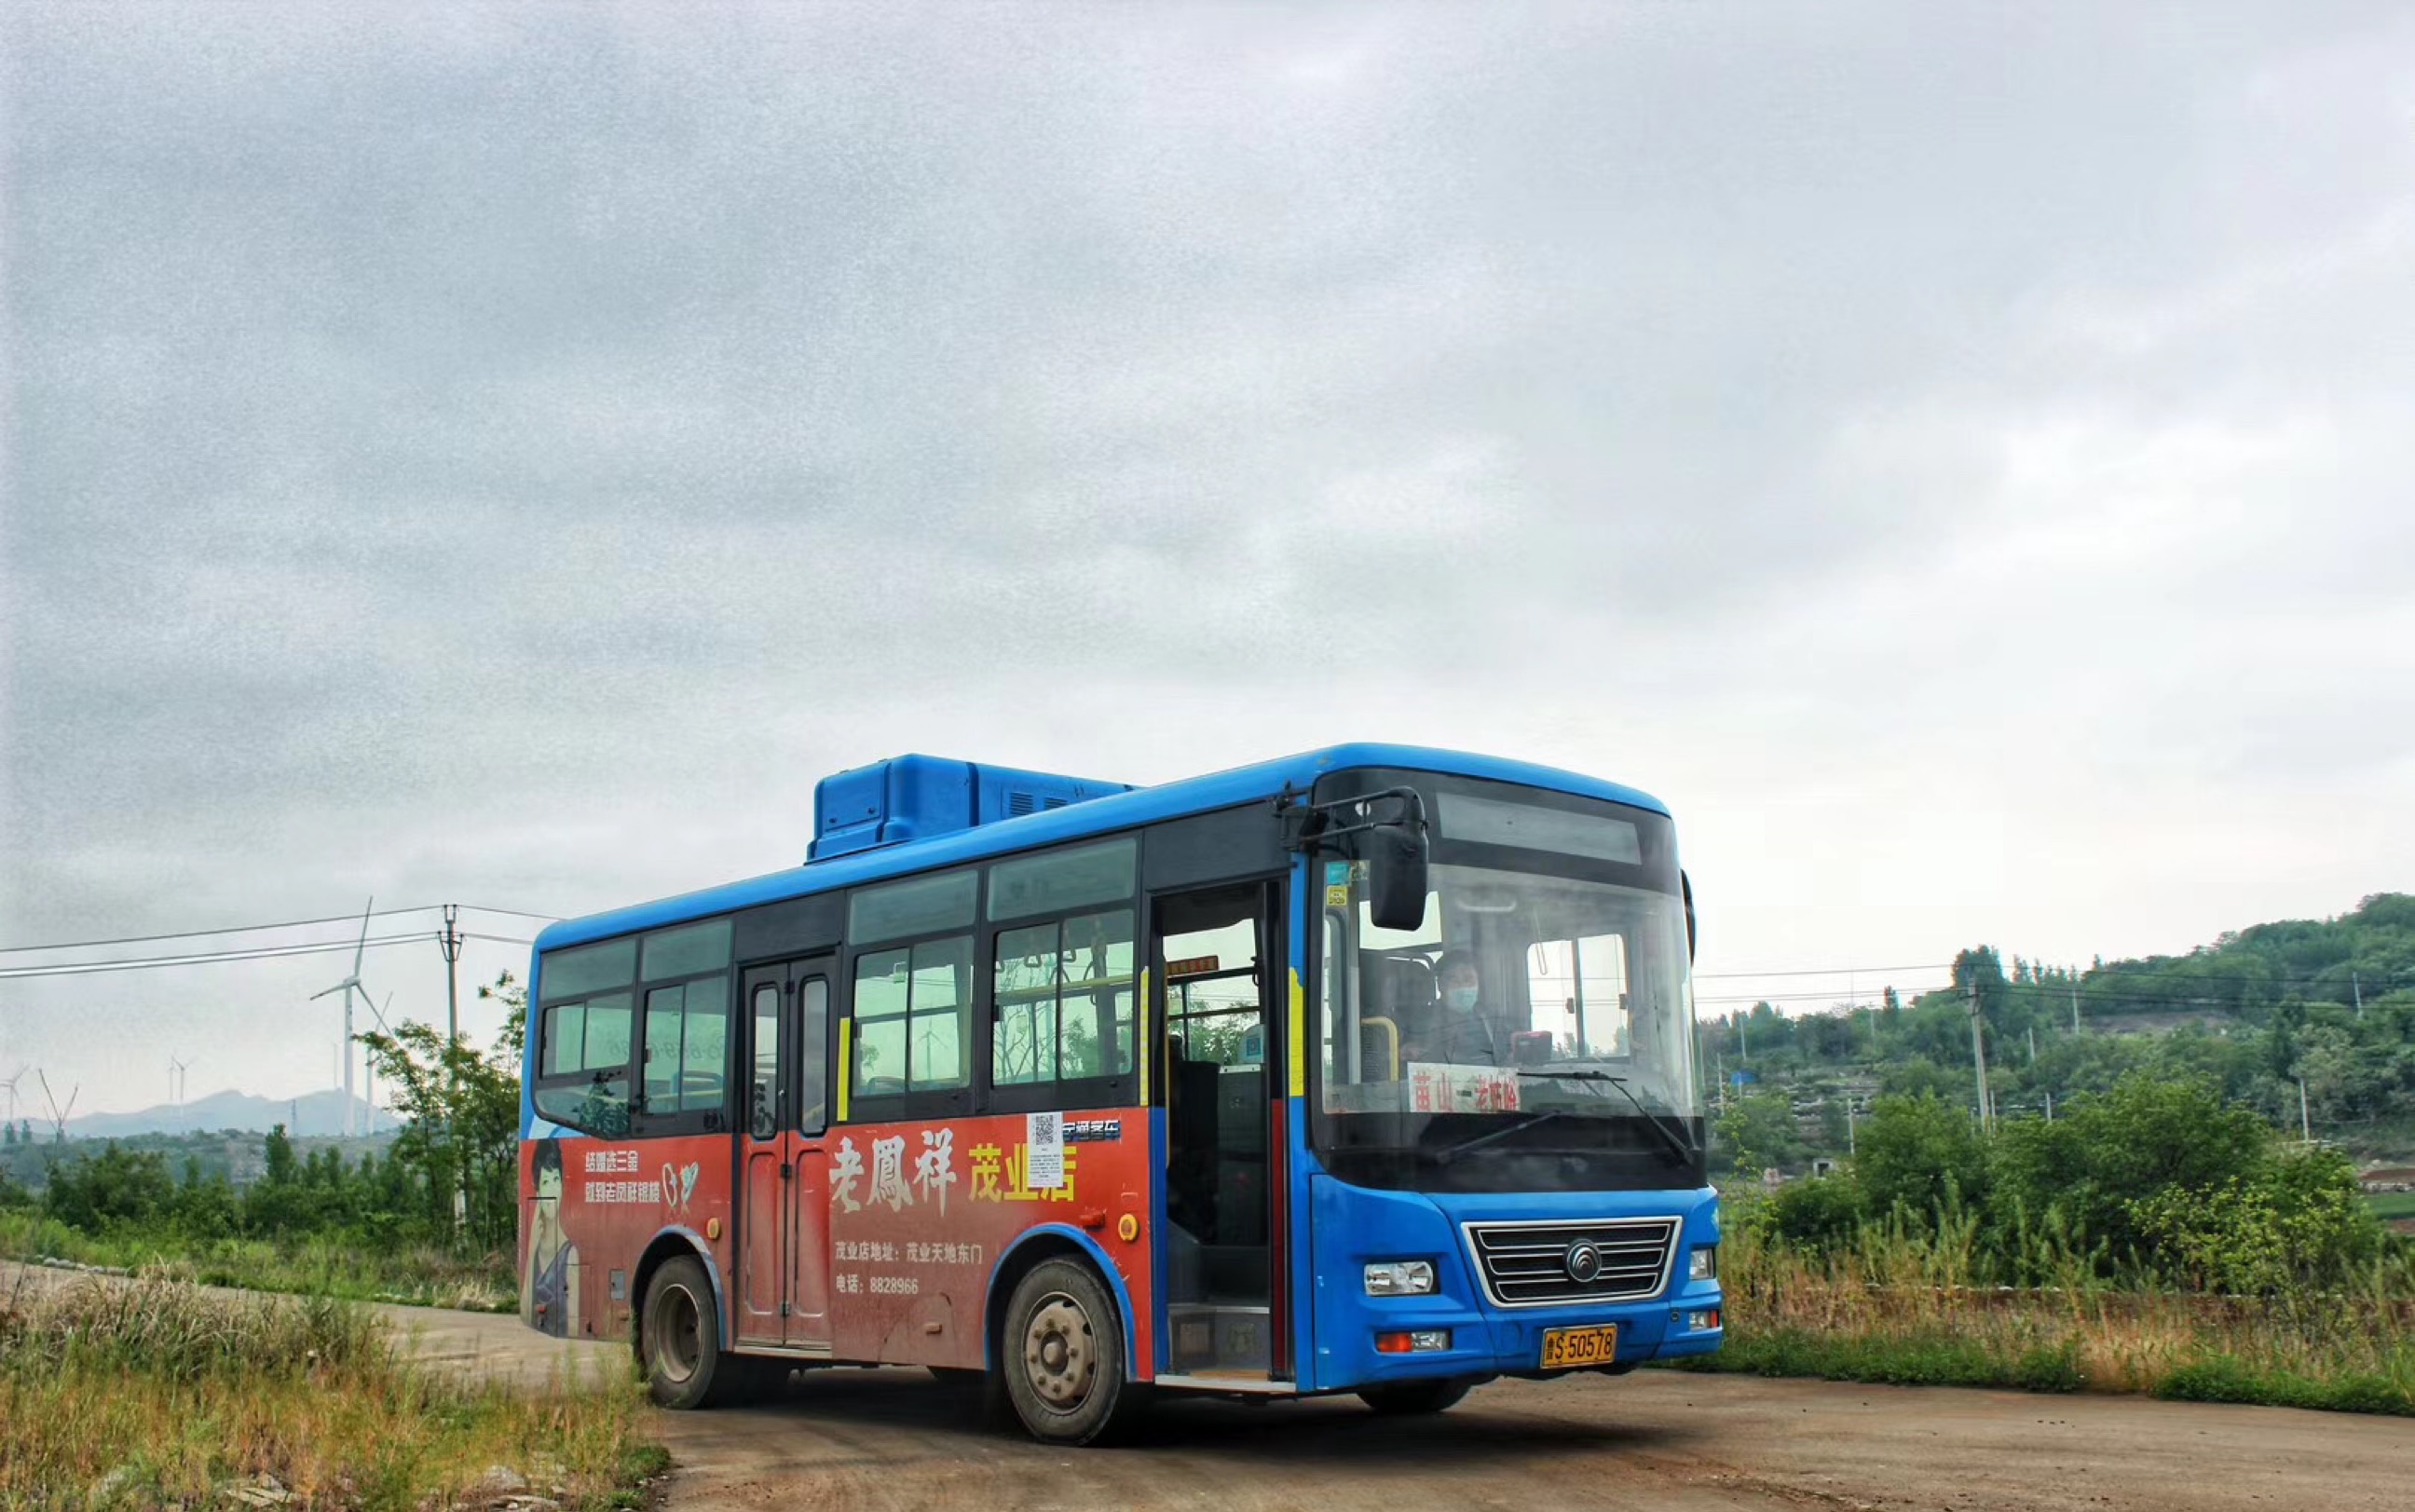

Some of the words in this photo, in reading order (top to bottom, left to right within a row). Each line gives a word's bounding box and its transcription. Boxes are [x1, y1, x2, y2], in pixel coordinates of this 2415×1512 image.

[585, 1151, 638, 1172] 结婚选三金
[585, 1181, 660, 1203] 就到老凤祥银楼
